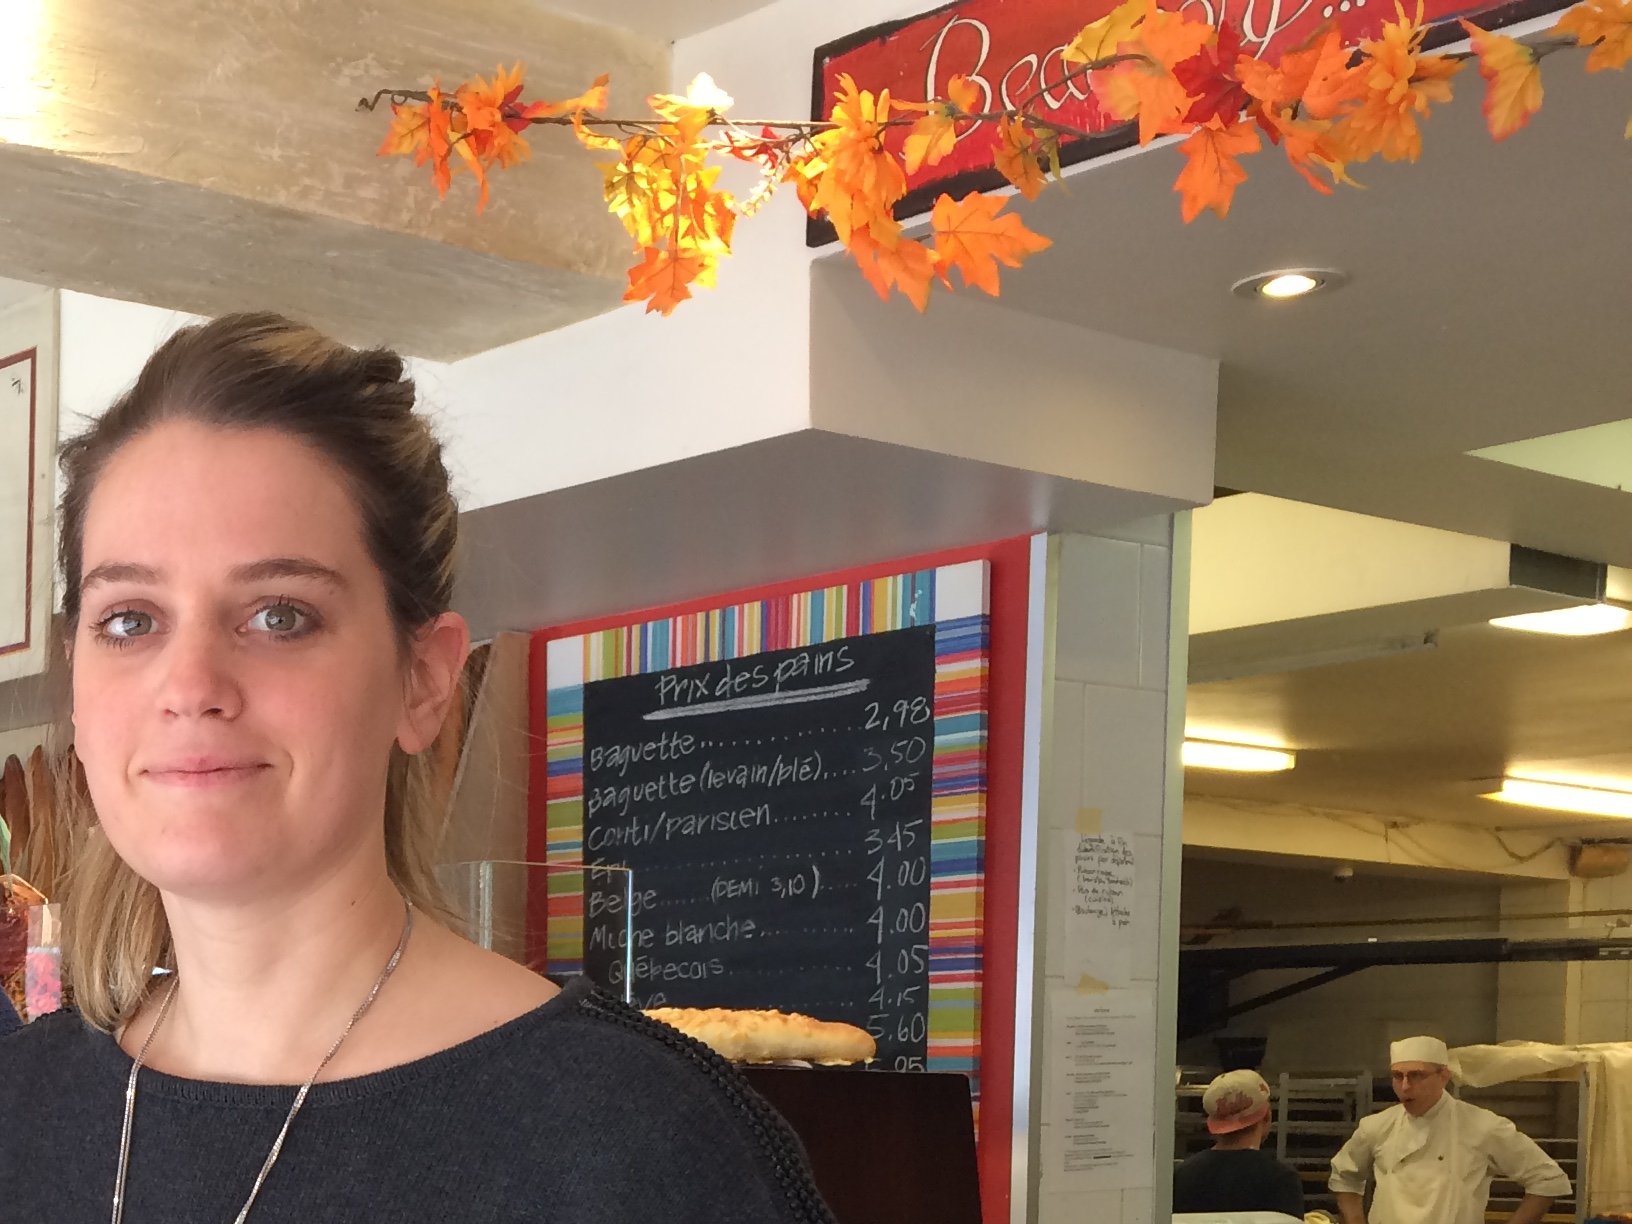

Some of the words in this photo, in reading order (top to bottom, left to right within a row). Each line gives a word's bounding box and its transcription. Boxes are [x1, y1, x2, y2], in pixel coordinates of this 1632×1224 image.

[655, 673, 710, 705] Prix
[715, 663, 769, 698] des
[773, 646, 855, 694] pains
[665, 913, 757, 946] blanche
